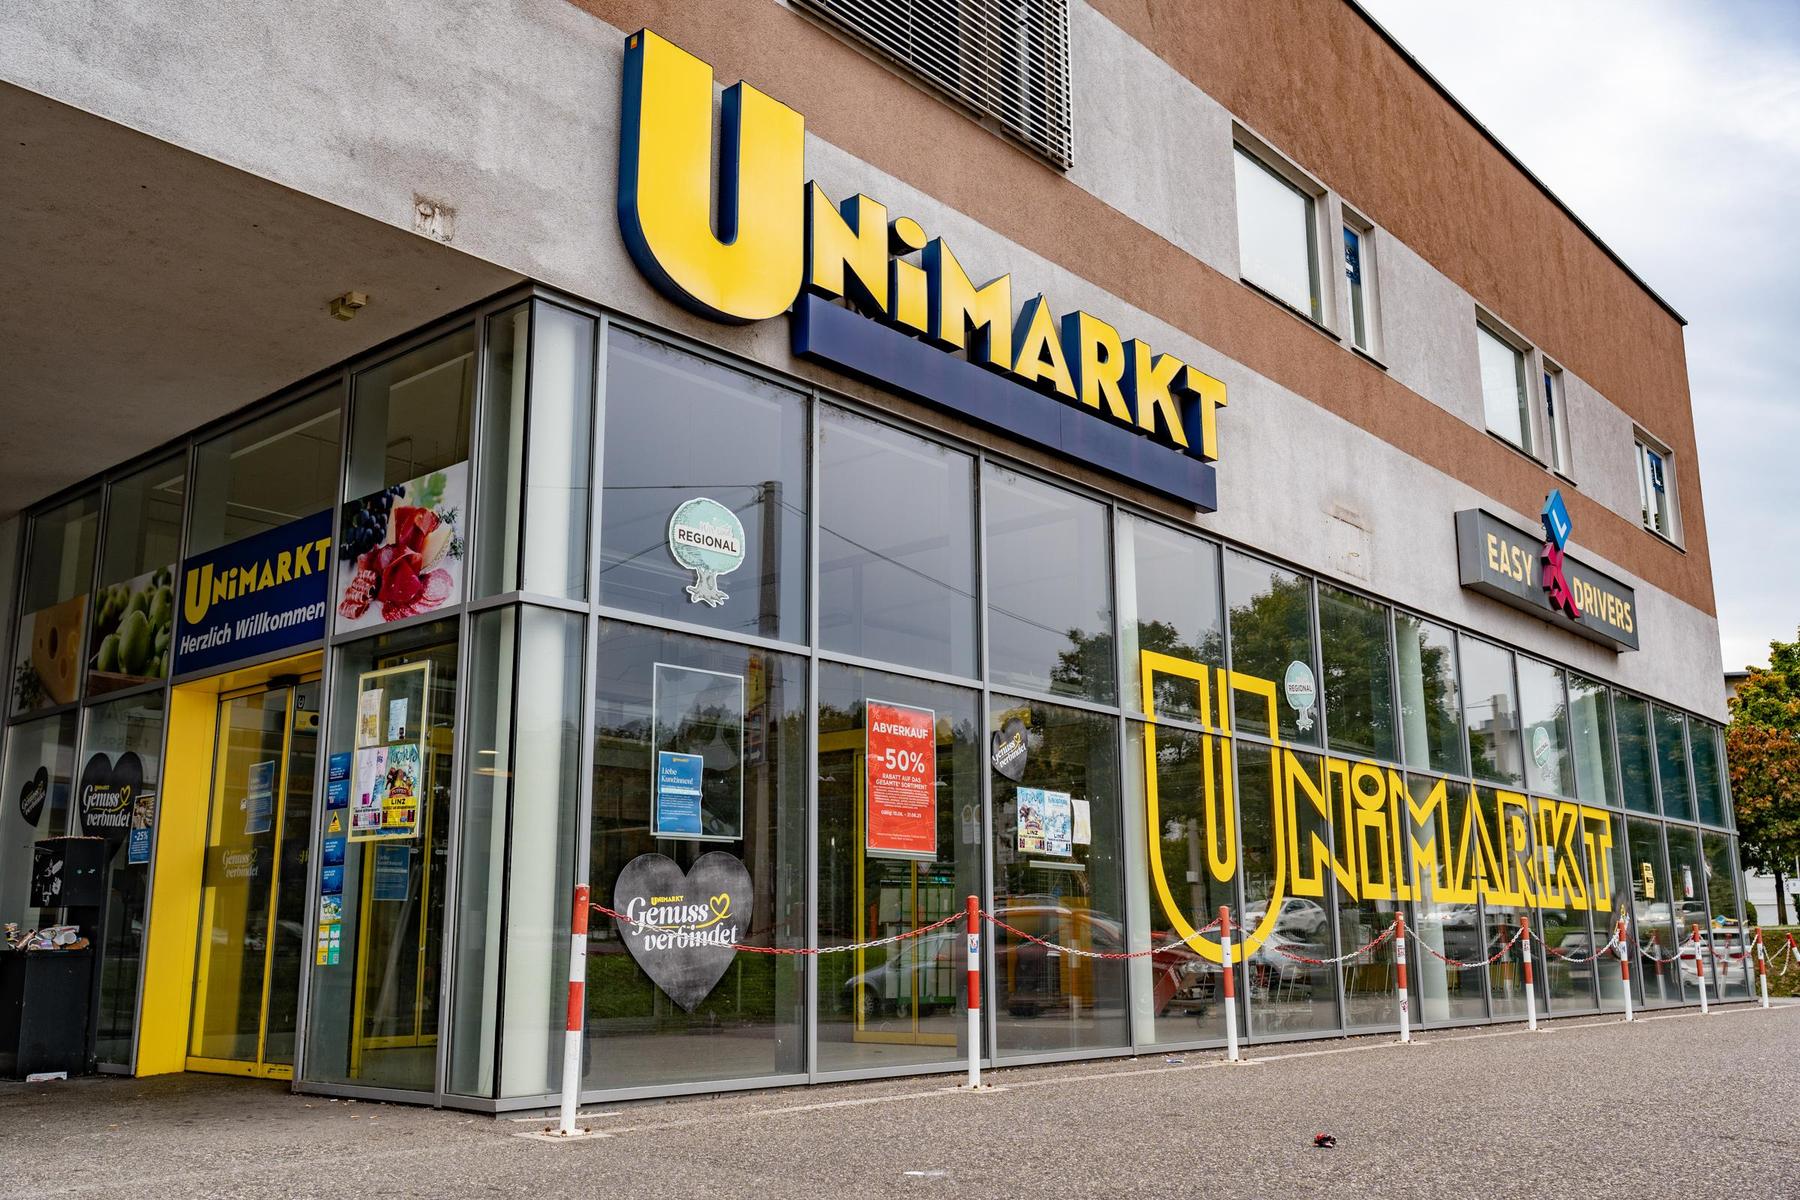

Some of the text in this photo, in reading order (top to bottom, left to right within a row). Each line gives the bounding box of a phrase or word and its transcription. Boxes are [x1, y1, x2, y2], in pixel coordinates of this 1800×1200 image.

[678, 528, 737, 553] REGIONAL
[1487, 533, 1633, 634] EASY DRIVERS
[179, 601, 326, 655] Herzlich Willkommen
[872, 722, 928, 739] ABVERKAUF
[877, 747, 925, 773] -50%
[83, 784, 120, 814] Genuss
[901, 782, 927, 790] SORTIMENT
[86, 809, 131, 827] verbindet
[626, 896, 709, 935] Genuss
[643, 922, 738, 951] verbindet
